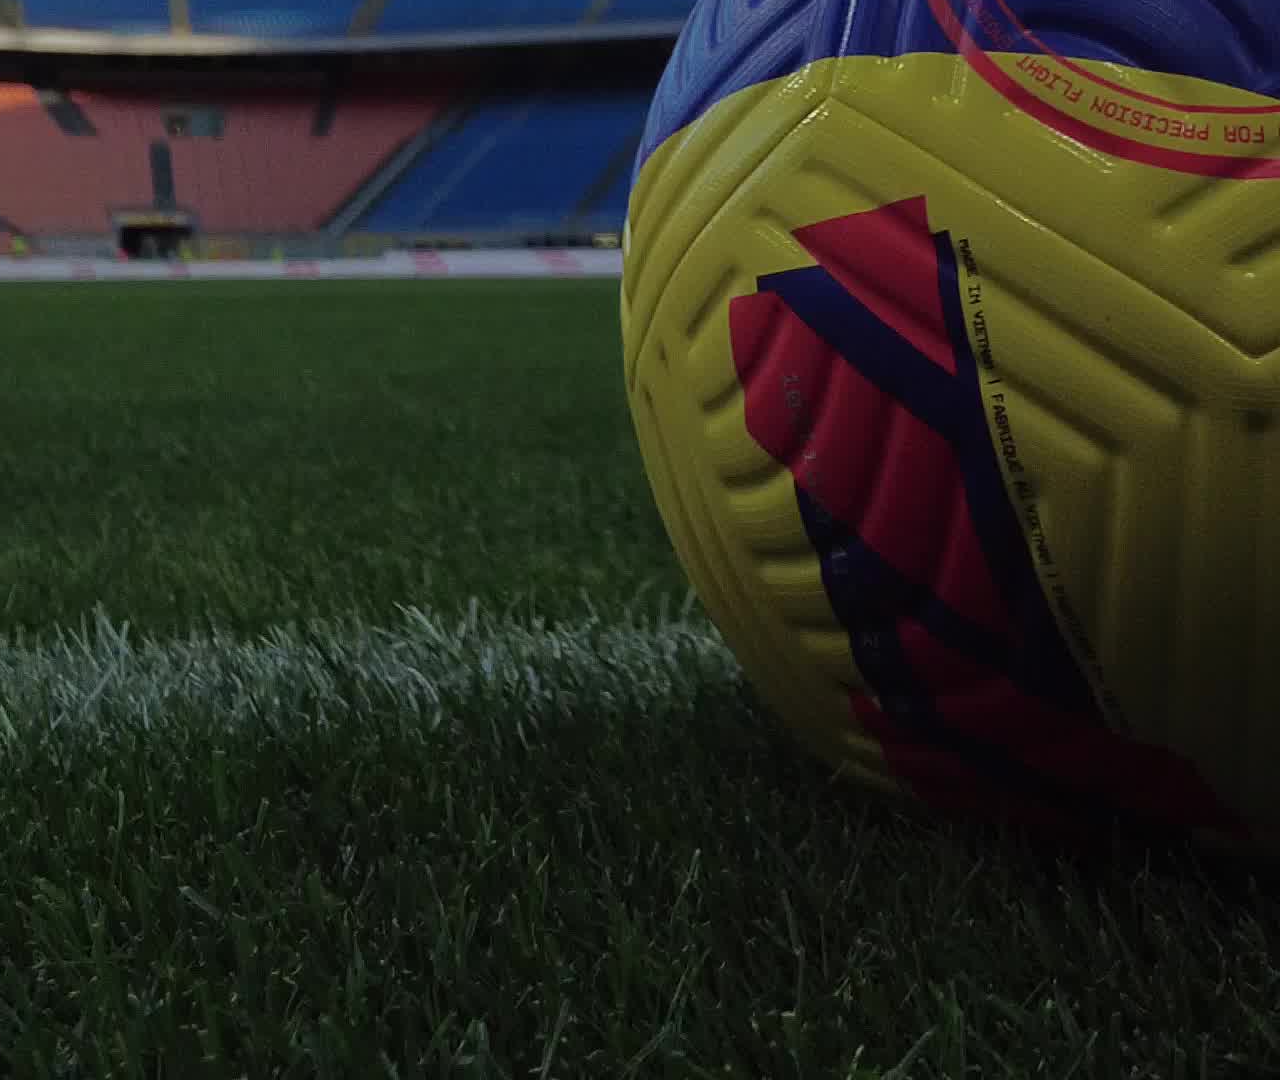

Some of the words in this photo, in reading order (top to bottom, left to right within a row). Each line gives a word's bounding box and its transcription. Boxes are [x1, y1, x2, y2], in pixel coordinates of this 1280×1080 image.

[1014, 54, 1084, 104] FLIGHT
[1088, 94, 1210, 141] PRECISION
[1223, 124, 1265, 144] FOR
